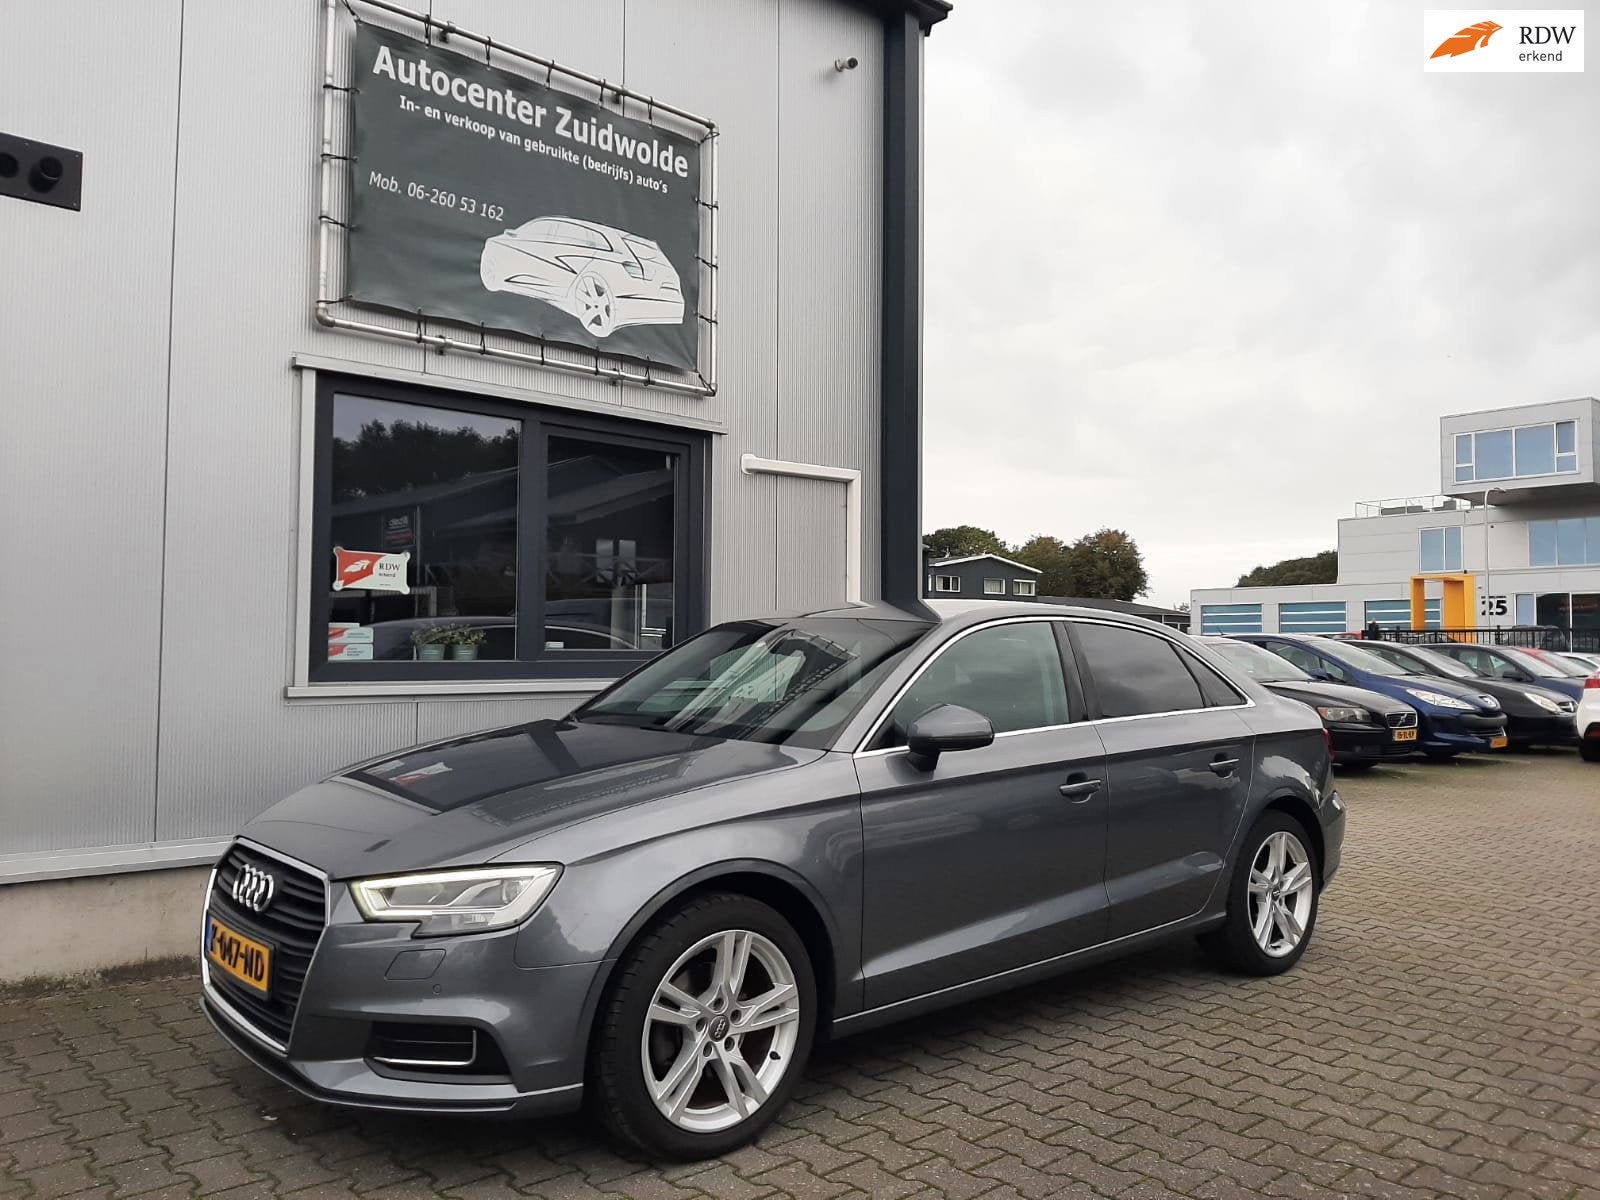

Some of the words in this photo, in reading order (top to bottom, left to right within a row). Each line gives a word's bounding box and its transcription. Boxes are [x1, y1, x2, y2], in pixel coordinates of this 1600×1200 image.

[372, 45, 547, 128] Autocenter
[555, 105, 689, 178] Zuidwolde
[400, 94, 420, 112] In-
[424, 106, 441, 120] en
[444, 111, 496, 139] verkoop
[499, 129, 521, 146] van
[524, 137, 580, 165] gebruikte
[582, 154, 634, 185] (bedrijfs)
[636, 174, 669, 194] auto's
[368, 170, 402, 194] Mob.
[407, 181, 456, 208] 06-260
[460, 196, 476, 214] 53
[480, 202, 504, 221] 162
[378, 562, 401, 571] RDW
[1481, 599, 1508, 616] 25
